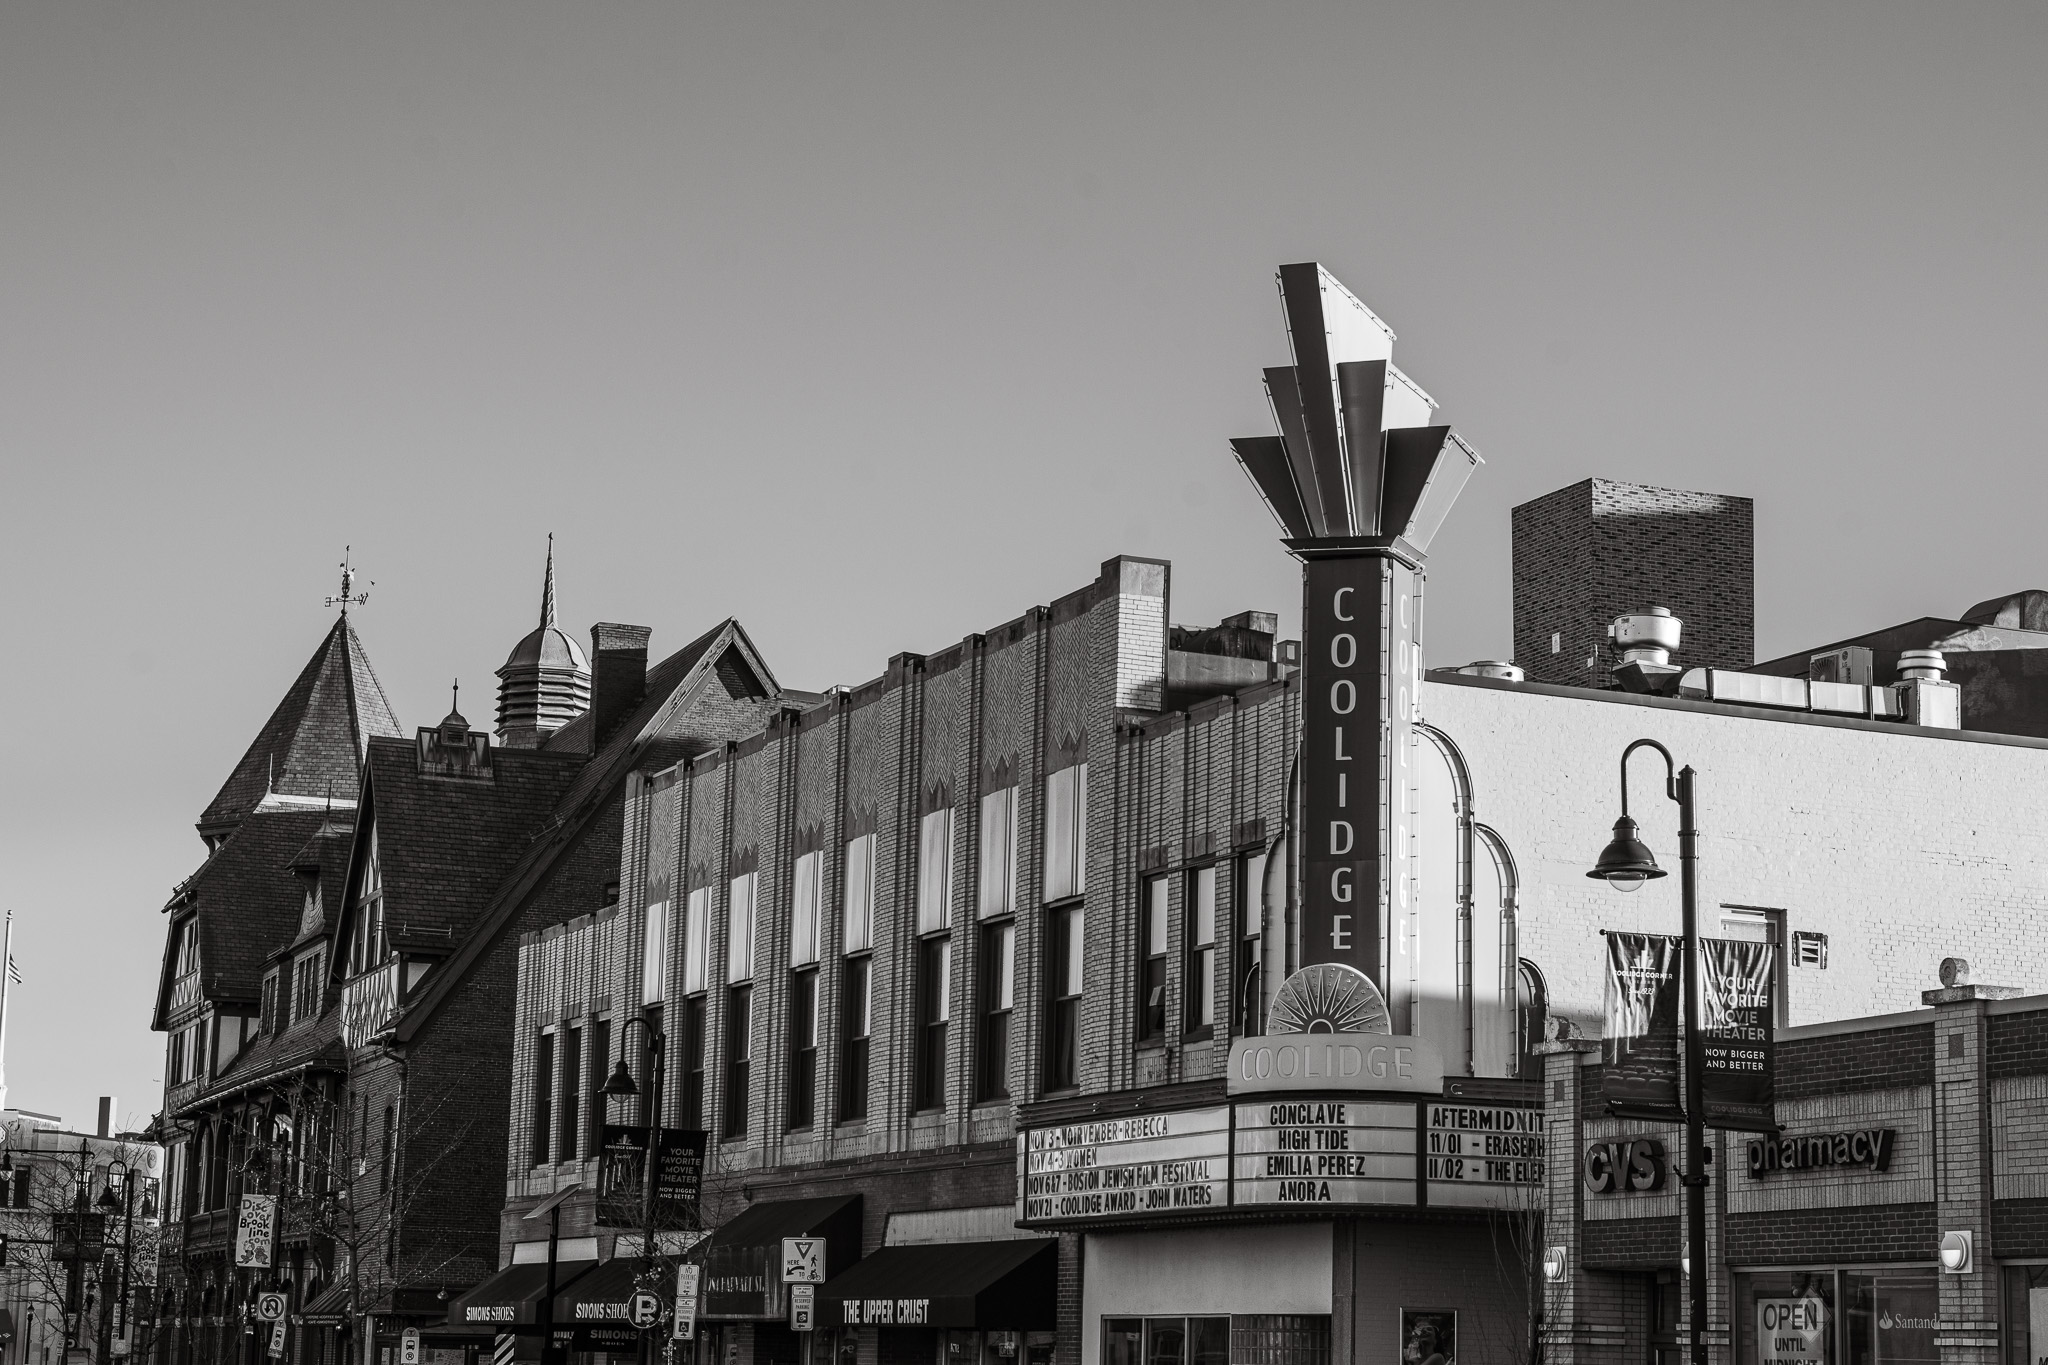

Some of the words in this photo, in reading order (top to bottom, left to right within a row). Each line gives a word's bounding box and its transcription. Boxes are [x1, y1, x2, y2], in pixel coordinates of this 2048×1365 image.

[1330, 586, 1357, 950] COOLIDGE
[1396, 593, 1409, 955] COOLIDGE
[1717, 975, 1756, 992] YOUR
[1705, 991, 1768, 1008] FAVORITE
[1714, 1009, 1758, 1025] MOVIE
[1705, 1025, 1766, 1041] THEATER
[1705, 1048, 1727, 1057] NOW
[1730, 1050, 1765, 1060] BIGGER
[1240, 1045, 1413, 1082] COOLIDGE
[1706, 1060, 1726, 1069] AND
[1729, 1061, 1764, 1071] BETTER
[1270, 1104, 1346, 1126] CONCLAVE
[1711, 1105, 1763, 1115] COOLIDGE.ORG
[1030, 1131, 1046, 1150] NOV
[1048, 1130, 1054, 1148] 3
[1061, 1122, 1118, 1146] NOIRVEMBER
[1124, 1116, 1168, 1139] REBECCA
[1278, 1129, 1310, 1150] HIGH
[1315, 1129, 1349, 1150] TIDE
[1430, 1132, 1462, 1154] 11/01
[670, 1148, 694, 1156] YOUR
[1029, 1152, 1046, 1172] NOV
[1048, 1151, 1054, 1169] 4
[1058, 1150, 1064, 1169] 3
[1066, 1147, 1097, 1168] WOMEN
[1747, 1129, 1892, 1179] pharmacy
[660, 1156, 701, 1166] FAVORITE
[1267, 1155, 1313, 1176] EMILIA
[1318, 1155, 1366, 1176] PEREZ
[1584, 1138, 1663, 1193] CVS
[665, 1166, 694, 1174] MOVIE
[1028, 1176, 1044, 1195] NOV
[1045, 1174, 1061, 1194] 6&7
[1067, 1170, 1099, 1191] BOSTON
[1102, 1167, 1134, 1188] JEWISH
[1136, 1165, 1159, 1186] FILM
[1162, 1160, 1210, 1184] FESTIVAL
[1428, 1158, 1464, 1180] 11/02
[1485, 1160, 1511, 1182] THE
[660, 1174, 698, 1184] THEATER
[1278, 1181, 1332, 1202] ANORA
[242, 1199, 268, 1212] Disc
[1028, 1199, 1044, 1217] NOV
[1044, 1198, 1052, 1216] 21
[1060, 1194, 1102, 1216] COOLIDGE
[1104, 1191, 1136, 1212] AWARD
[1145, 1188, 1170, 1209] JOHN
[1173, 1184, 1212, 1207] WATERS
[240, 1218, 270, 1229] Brook
[247, 1211, 271, 1221] over
[248, 1227, 270, 1238] line
[131, 1245, 157, 1255] Brook
[139, 1252, 156, 1262] line
[684, 1267, 693, 1275] NO
[754, 1275, 765, 1293] ST.
[466, 1306, 491, 1321] SIMONS
[490, 1306, 515, 1321] SHOES
[575, 1302, 605, 1319] SIMONS
[605, 1303, 628, 1319] SHOE
[843, 1299, 860, 1324] THE
[863, 1299, 894, 1324] UPPER
[897, 1298, 929, 1324] CRUST
[1763, 1303, 1817, 1331] OPEN
[590, 1329, 638, 1340] SIMONS
[1774, 1337, 1806, 1352] UNTIL
